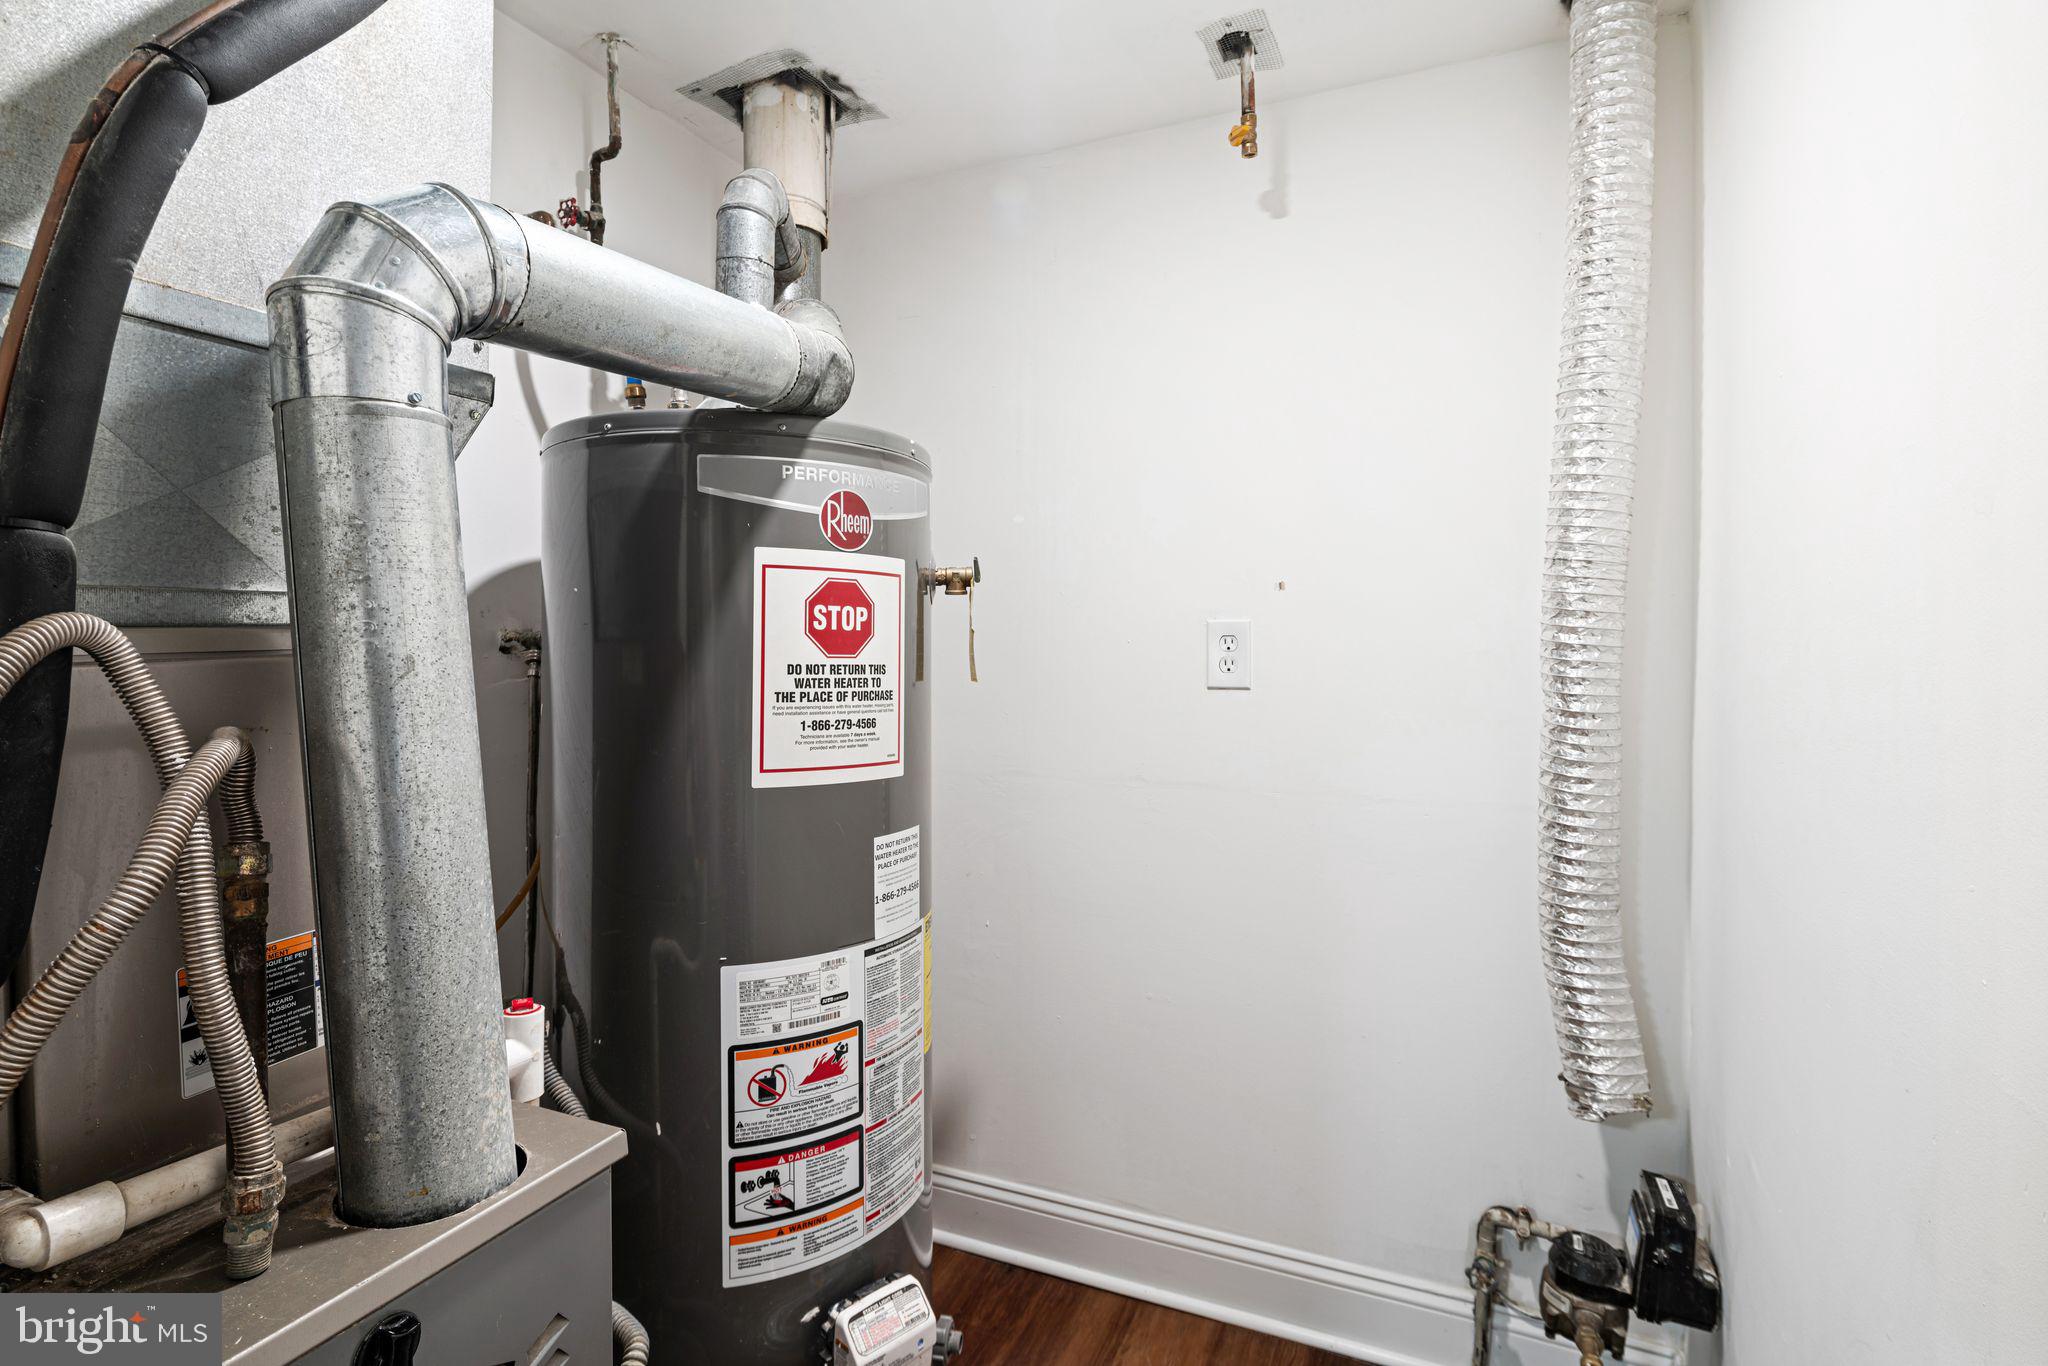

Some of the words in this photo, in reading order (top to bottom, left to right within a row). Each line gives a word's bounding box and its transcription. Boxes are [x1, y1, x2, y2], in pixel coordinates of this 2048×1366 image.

[782, 465, 901, 493] PERFORMANCE
[827, 491, 870, 541] Rheem
[813, 604, 868, 631] STOP
[787, 664, 802, 675] DO
[806, 664, 826, 675] NOT
[830, 664, 866, 675] RETURN
[868, 664, 886, 675] THIS
[794, 678, 831, 688] WATER
[834, 678, 868, 688] HEATER
[871, 677, 882, 688] TO
[774, 692, 796, 702] THE
[800, 692, 833, 702] PLACE
[836, 691, 848, 702] OF
[852, 690, 894, 701] PURCHASE
[800, 718, 877, 732] 1-866-279-4566
[876, 843, 884, 851] DO
[885, 840, 895, 849] NOT
[896, 836, 910, 846] RETURN
[875, 852, 892, 861] WATER
[892, 846, 907, 856] HEATER
[878, 861, 892, 870] PLACE
[267, 995, 294, 1008] HAZARD
[267, 1001, 296, 1015] PLOSION
[784, 1038, 829, 1053] WARNING
[798, 1085, 823, 1094] Flammable
[815, 1095, 831, 1104] HAZARD
[788, 1145, 826, 1162] DANGER
[788, 1216, 827, 1233] WARNING
